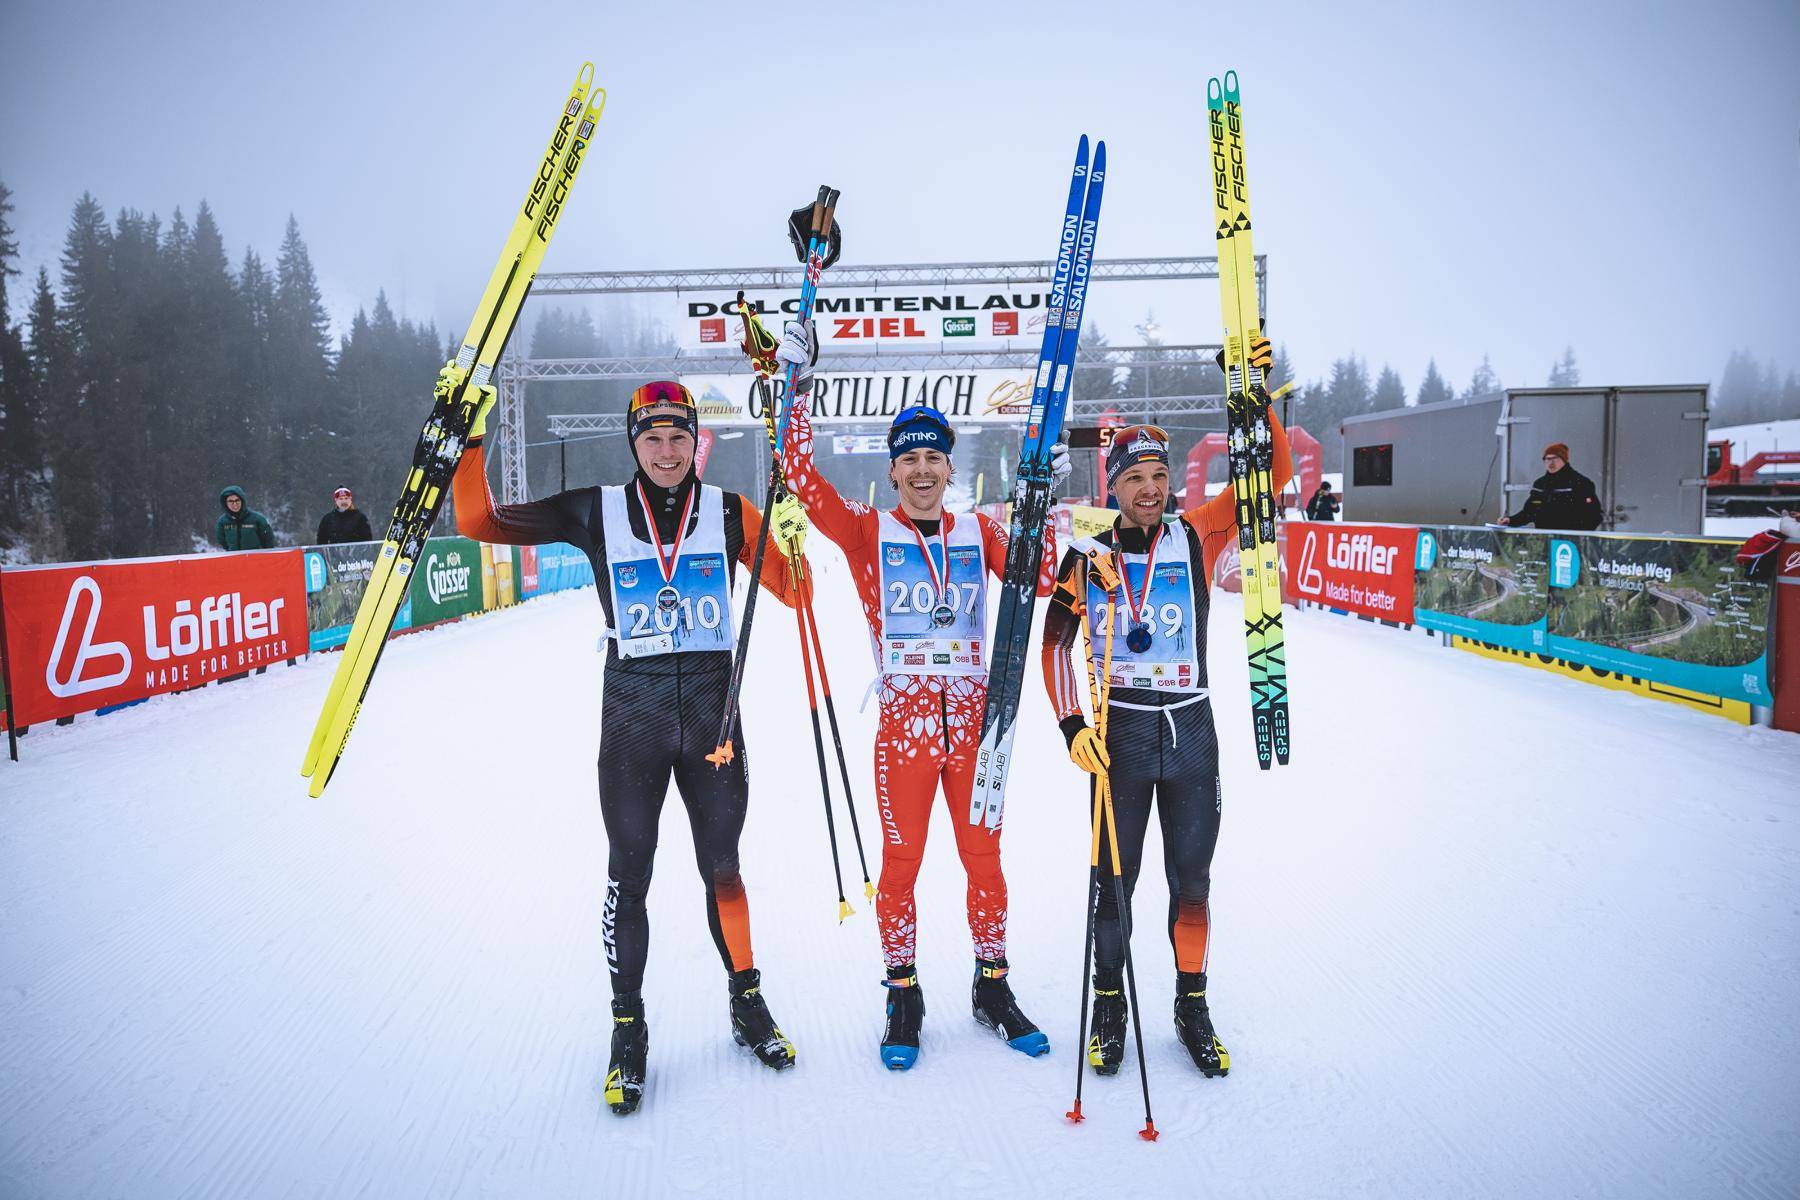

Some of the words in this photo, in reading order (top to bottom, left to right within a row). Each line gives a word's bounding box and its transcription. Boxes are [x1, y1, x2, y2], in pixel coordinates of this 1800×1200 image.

[524, 115, 574, 221] FISCHER
[1211, 108, 1229, 211] FISCHER
[1227, 100, 1246, 203] FISCHER
[1051, 214, 1079, 307] SALOMON
[1069, 220, 1096, 311] SALOMON
[832, 317, 926, 339] ZIEL
[944, 320, 974, 333] Gösser
[748, 374, 977, 419] OBRTILLIACH
[1327, 533, 1399, 576] Löffler
[1612, 560, 1643, 577] beste
[1645, 562, 1672, 583] Weg
[426, 553, 470, 604] Gösser
[888, 580, 980, 615] 2007
[1325, 580, 1349, 601] Made
[1350, 584, 1364, 605] for
[1365, 586, 1397, 611] better
[143, 592, 285, 661] Löffler
[627, 595, 720, 637] 2010
[146, 665, 189, 688] MADE
[201, 655, 228, 676] FOR
[238, 640, 288, 667] BETTER
